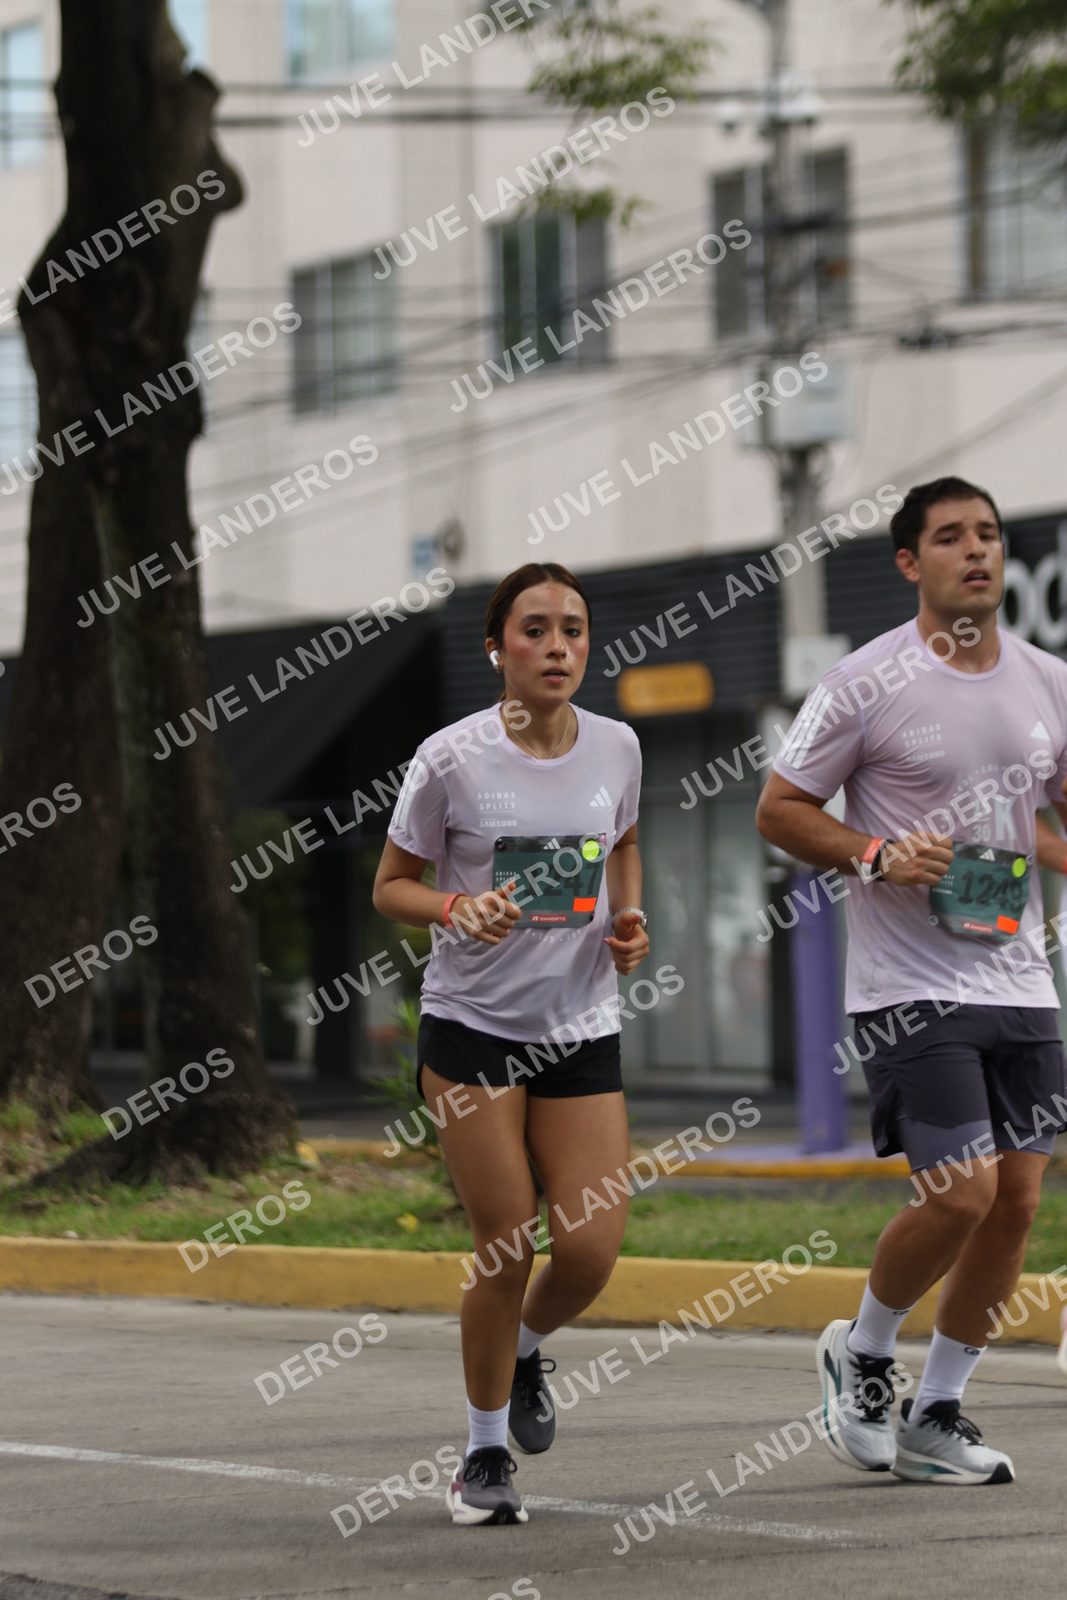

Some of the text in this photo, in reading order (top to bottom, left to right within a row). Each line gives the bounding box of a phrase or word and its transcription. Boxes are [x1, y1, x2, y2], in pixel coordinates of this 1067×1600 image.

[477, 791, 516, 800] ADIDAS
[479, 801, 516, 810] SPLITS
[479, 819, 518, 828] SAMSUNG
[973, 823, 991, 842] 30
